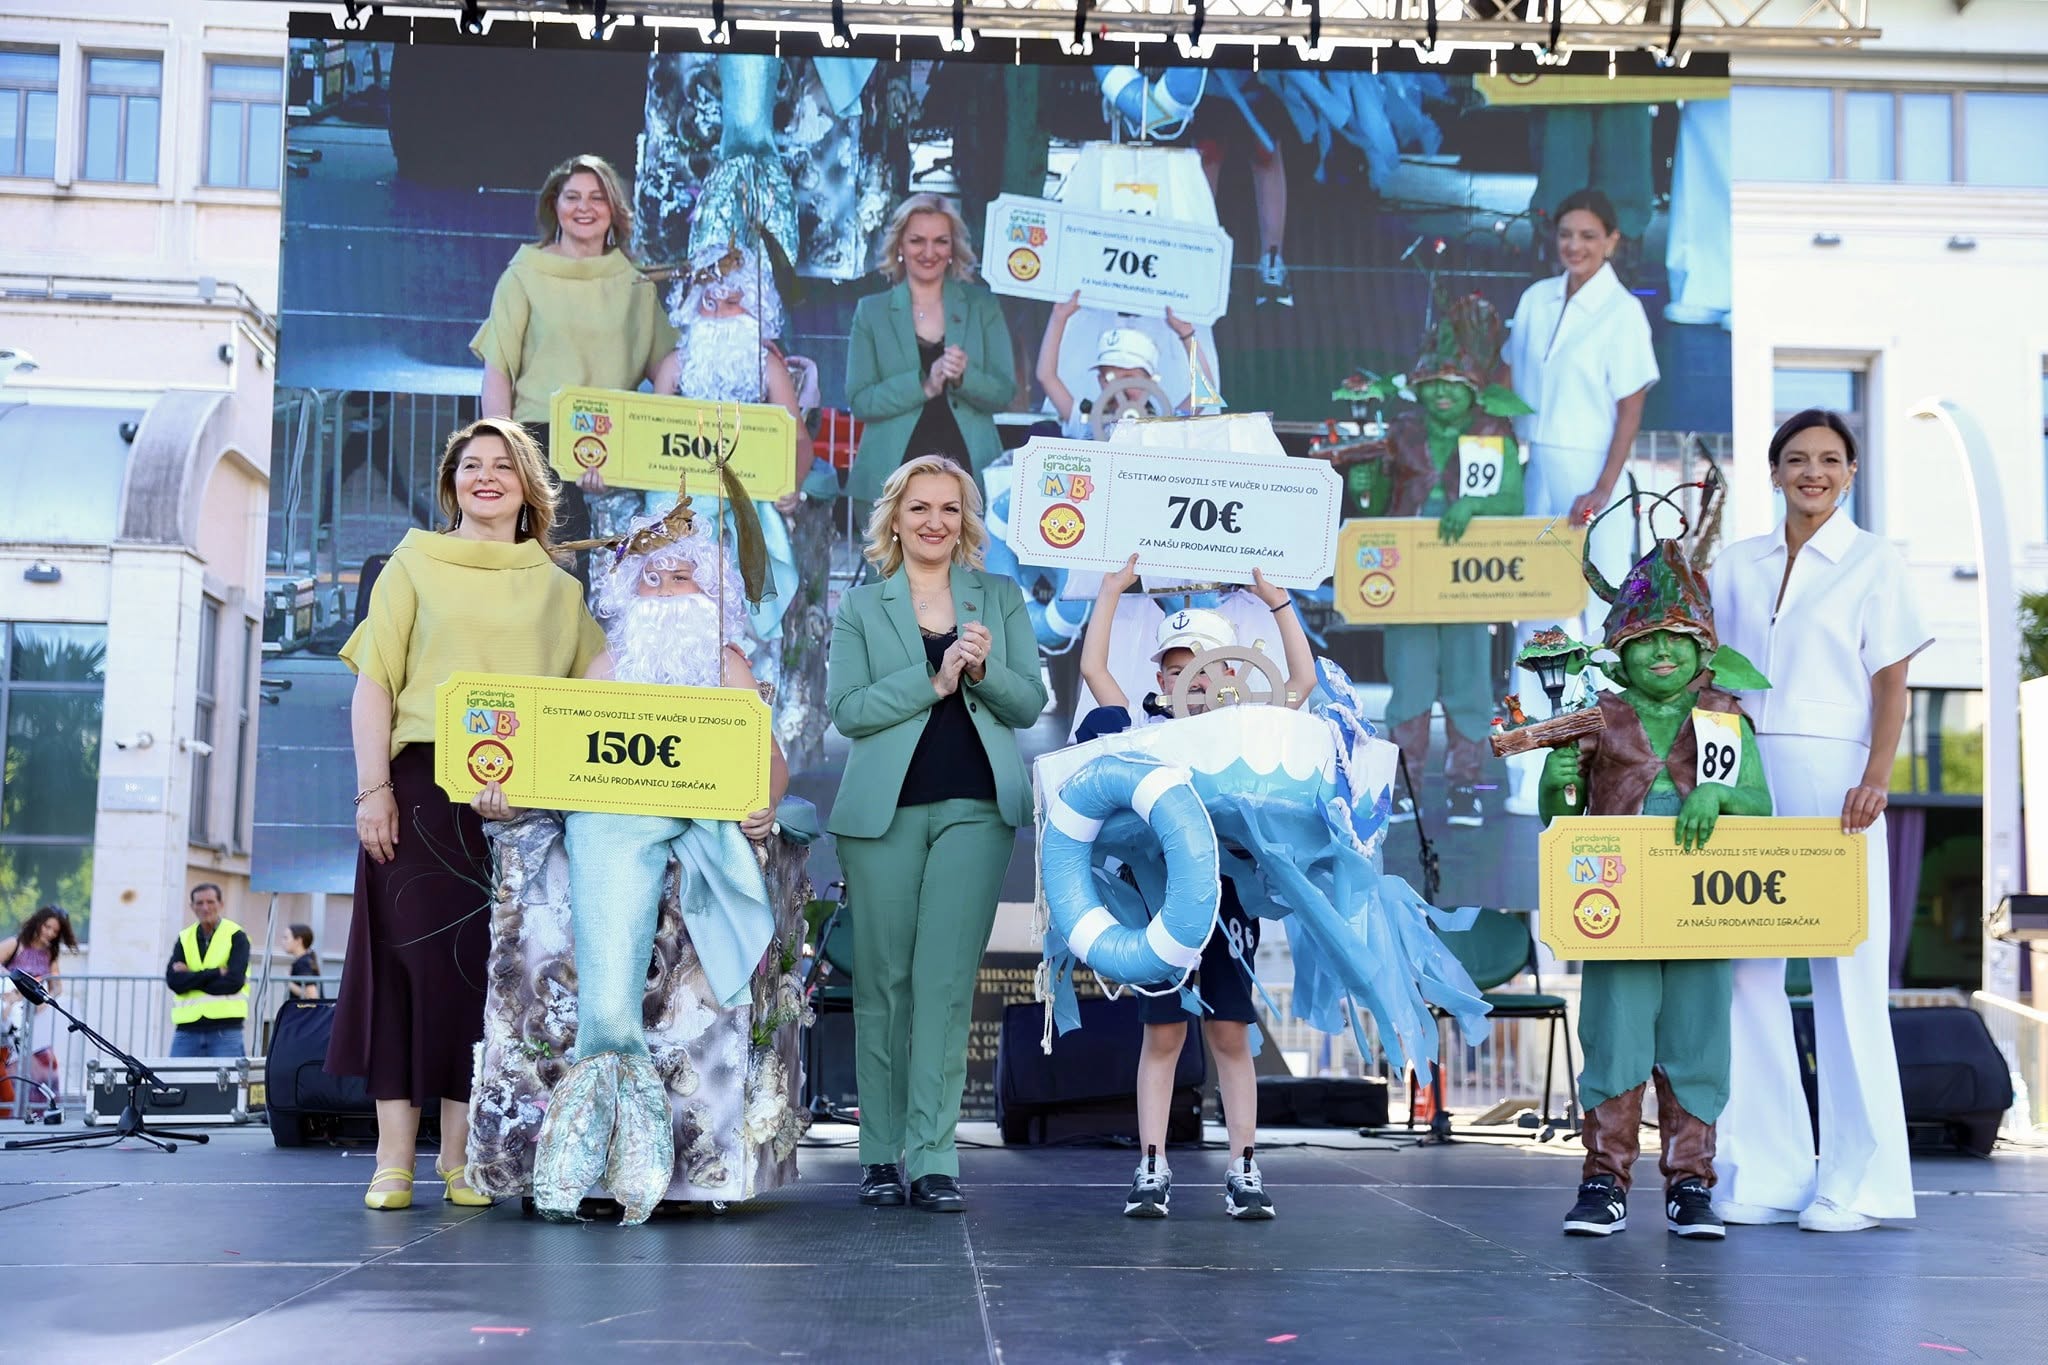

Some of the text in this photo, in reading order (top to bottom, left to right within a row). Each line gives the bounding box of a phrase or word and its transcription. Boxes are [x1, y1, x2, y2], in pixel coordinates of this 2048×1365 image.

[1103, 247, 1159, 279] 70€
[1047, 454, 1091, 462] prodavnica
[1117, 469, 1166, 482] ČESTITAMO
[1168, 475, 1208, 486] OSVOJILI
[1210, 479, 1226, 488] STE
[1228, 480, 1260, 490] VAUČER
[1270, 484, 1304, 494] IZNOSU
[1305, 487, 1318, 495] OD
[1466, 462, 1496, 488] 89
[1167, 496, 1243, 534] 70€
[1138, 538, 1284, 557] ZA NAŠU PRODAVNICU IGRAČAKA
[1451, 556, 1524, 583] 100€
[470, 690, 515, 698] prodavnica
[542, 705, 746, 726] ČESTITAMO OSVOJILI STE VAUČER U IZNOSU OD
[586, 730, 681, 768] 150€
[1702, 742, 1736, 781] 89
[568, 773, 716, 790] ZA NAŠU PRODAVNICU IGRAČAKA
[1575, 834, 1620, 842] prodavnica
[1648, 846, 1846, 856] ČESTITAMO OSVOJILI STE VAUČER U IZNOSU OD
[1691, 870, 1786, 906] 100€
[1676, 915, 1820, 927] ZA NAŠU PRODAVNICU IGRAČAKA
[1228, 917, 1254, 960] 86
